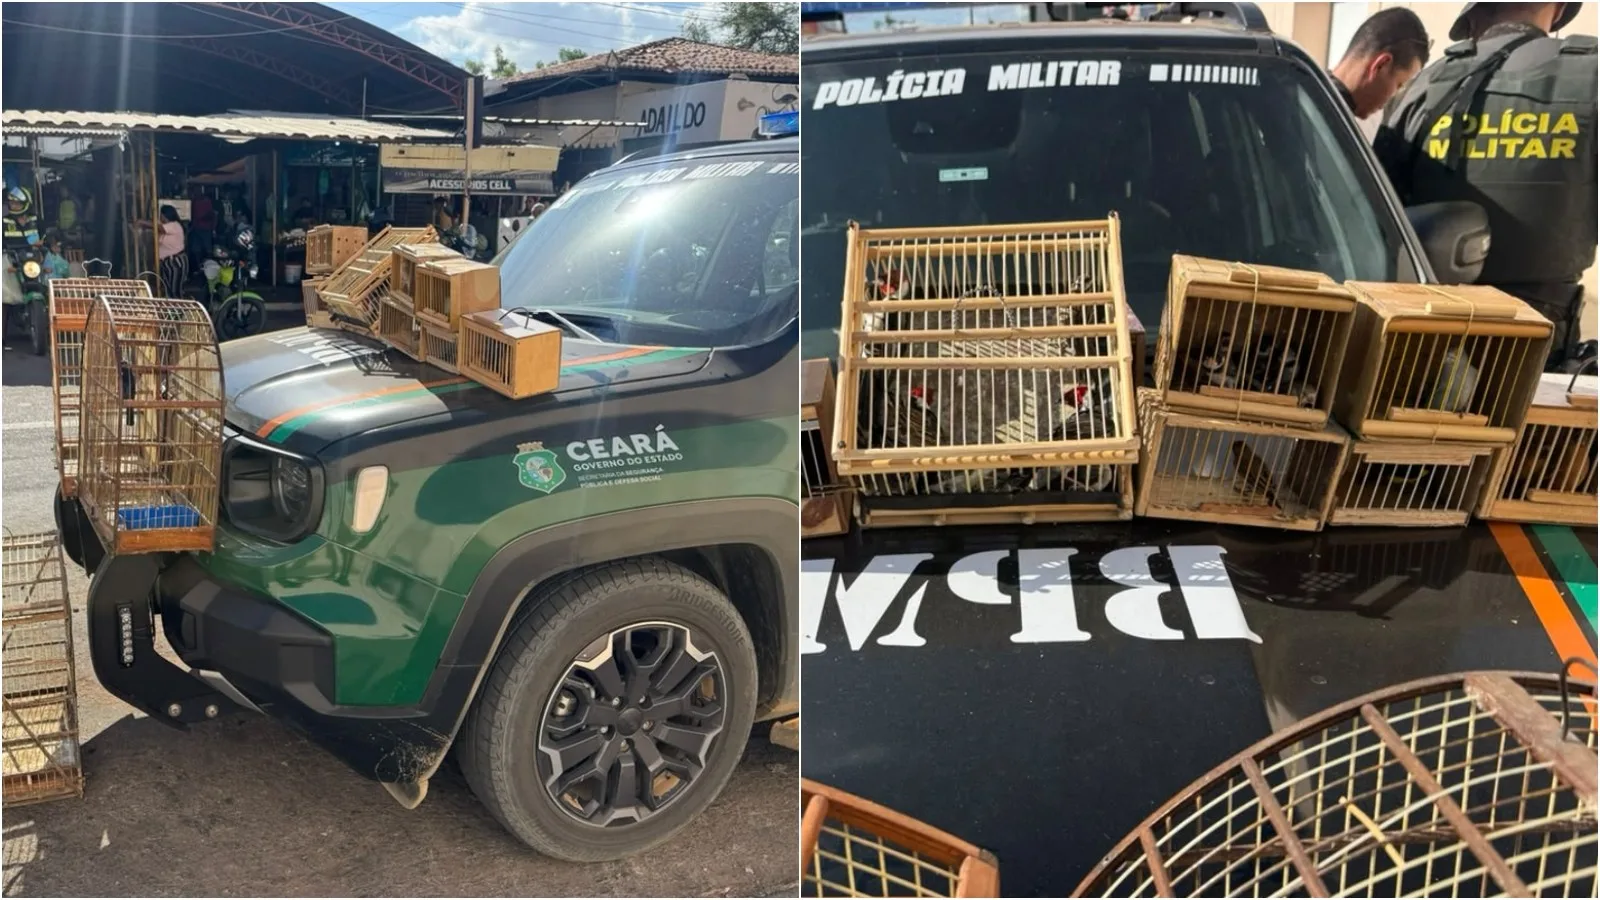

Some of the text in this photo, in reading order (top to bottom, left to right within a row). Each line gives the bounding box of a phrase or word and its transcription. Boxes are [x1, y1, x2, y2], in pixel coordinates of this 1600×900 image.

[813, 60, 1122, 110] POLÍCIA MILITAR
[489, 180, 511, 190] CELL
[566, 424, 679, 461] CEARÁ
[573, 453, 683, 471] GOVERNO DO ESTADO
[614, 477, 640, 485] DEFESA
[616, 470, 625, 478] DA
[625, 467, 664, 476] SEGURANÇA
[666, 586, 746, 647] BRIDGESTONE
